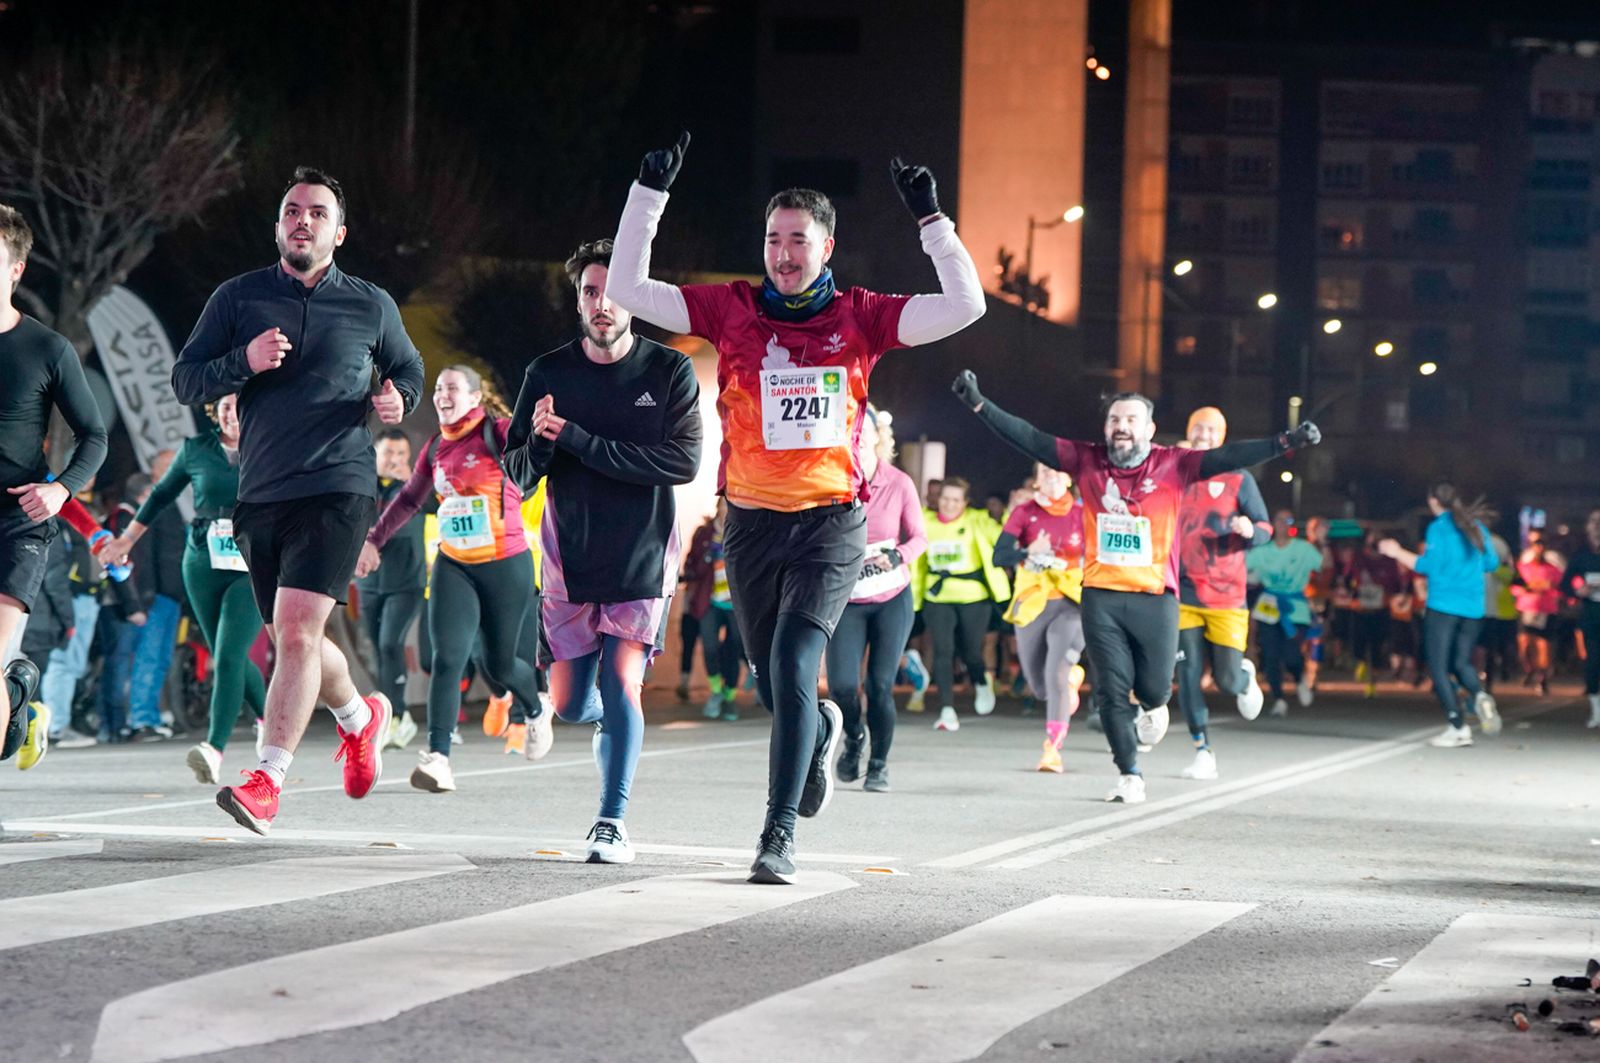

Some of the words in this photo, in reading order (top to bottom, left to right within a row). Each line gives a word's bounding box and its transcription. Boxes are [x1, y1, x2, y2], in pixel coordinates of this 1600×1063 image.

[132, 321, 183, 443] PEMASA
[780, 377, 804, 386] NOCHE
[806, 376, 816, 384] DE
[772, 388, 786, 396] SAN
[788, 384, 816, 396] ANTÓN
[780, 396, 830, 421] 2247
[452, 516, 473, 532] 511
[219, 537, 239, 551] 14
[1107, 532, 1140, 549] 7969
[858, 563, 889, 580] 65
